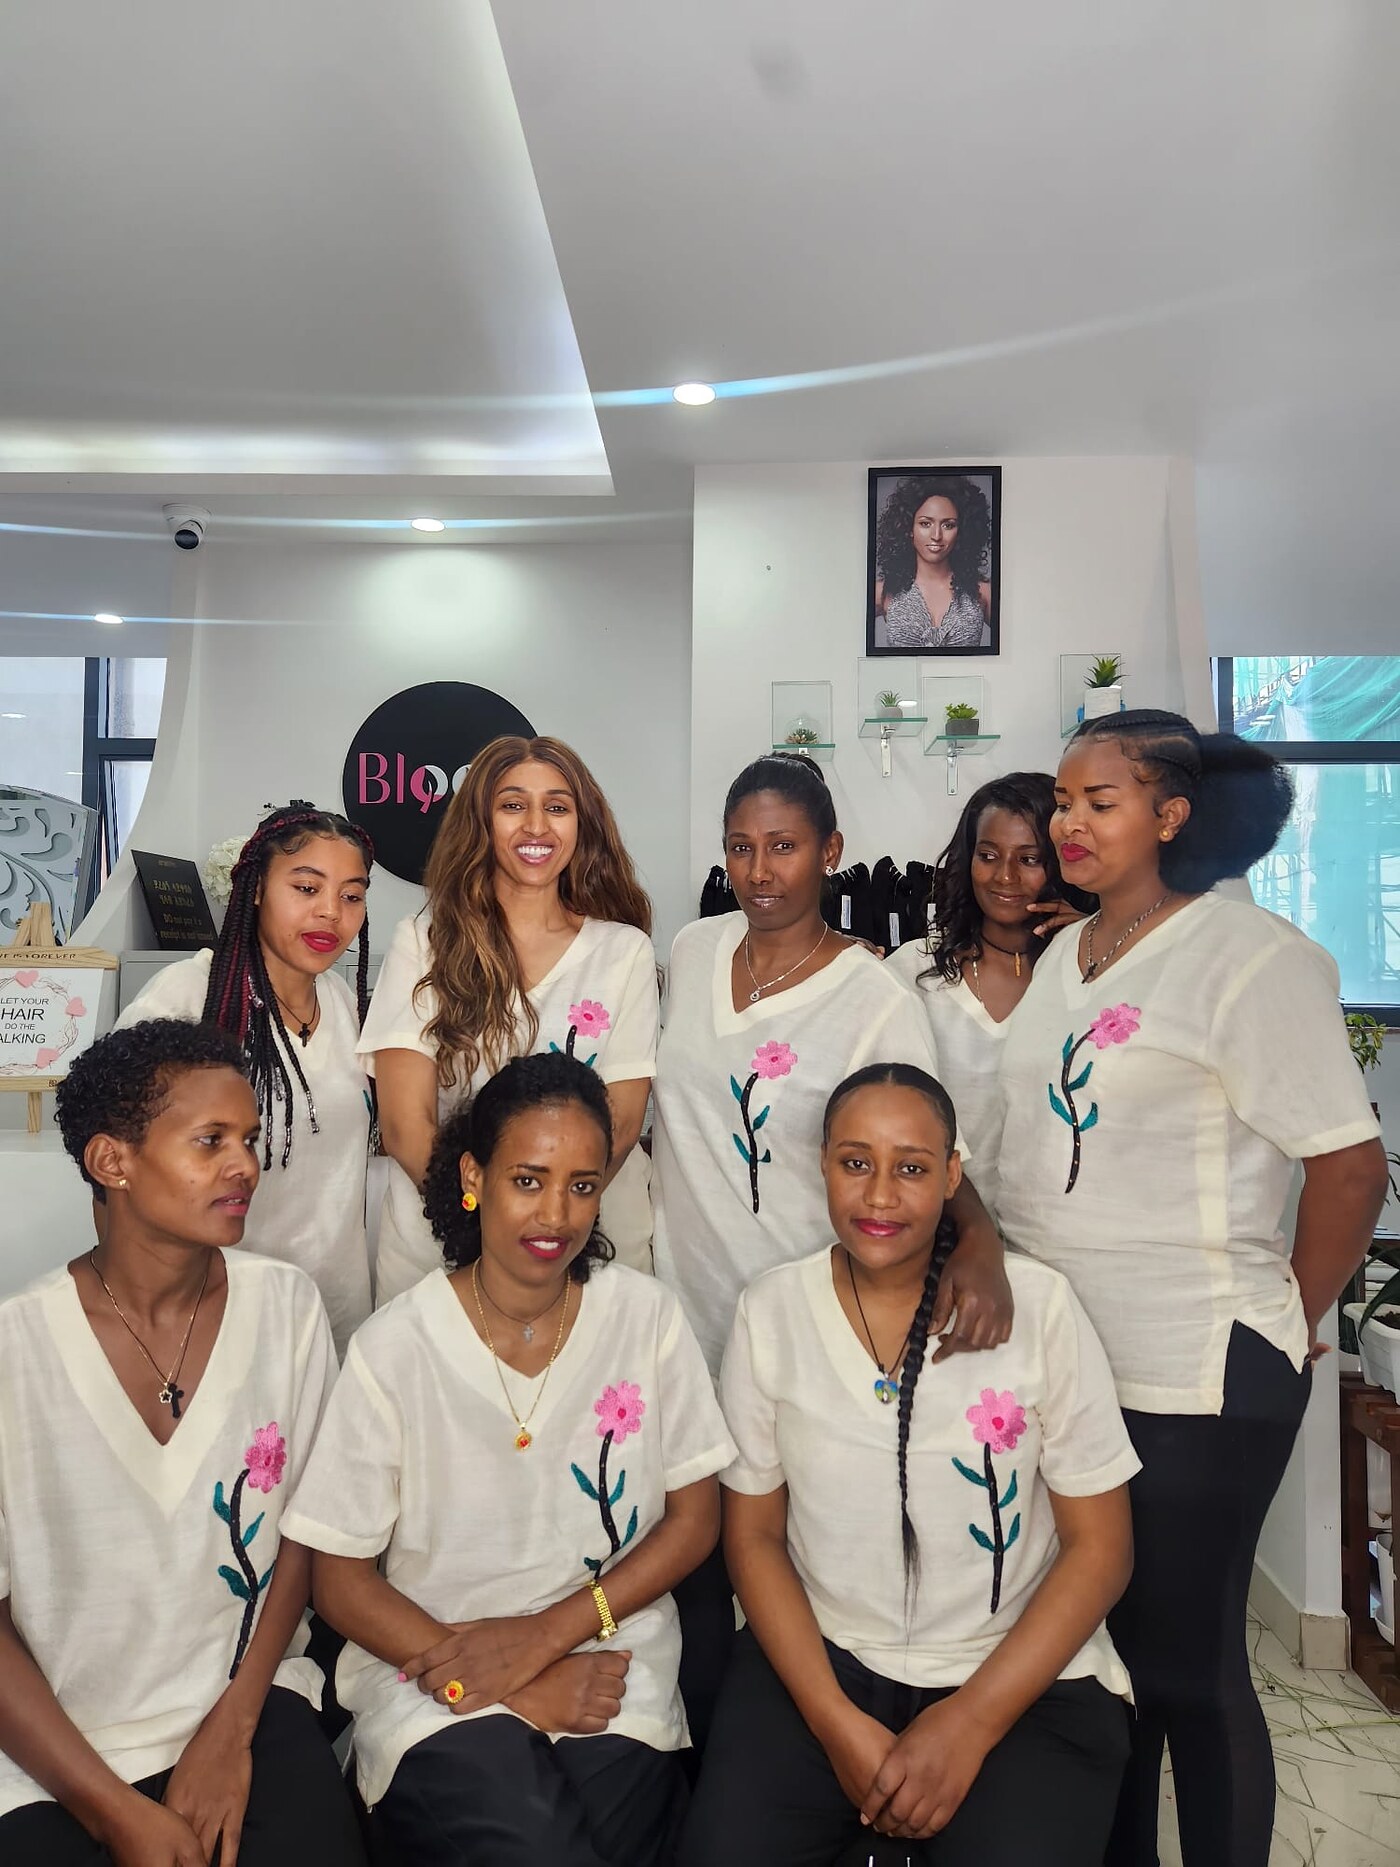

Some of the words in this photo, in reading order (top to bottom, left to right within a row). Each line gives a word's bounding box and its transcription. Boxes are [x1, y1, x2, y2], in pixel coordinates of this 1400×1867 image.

[0, 997, 20, 1005] LET
[20, 997, 50, 1005] YOUR
[1, 1007, 45, 1021] HAIR
[4, 1022, 18, 1030] DO
[19, 1023, 36, 1031] THE
